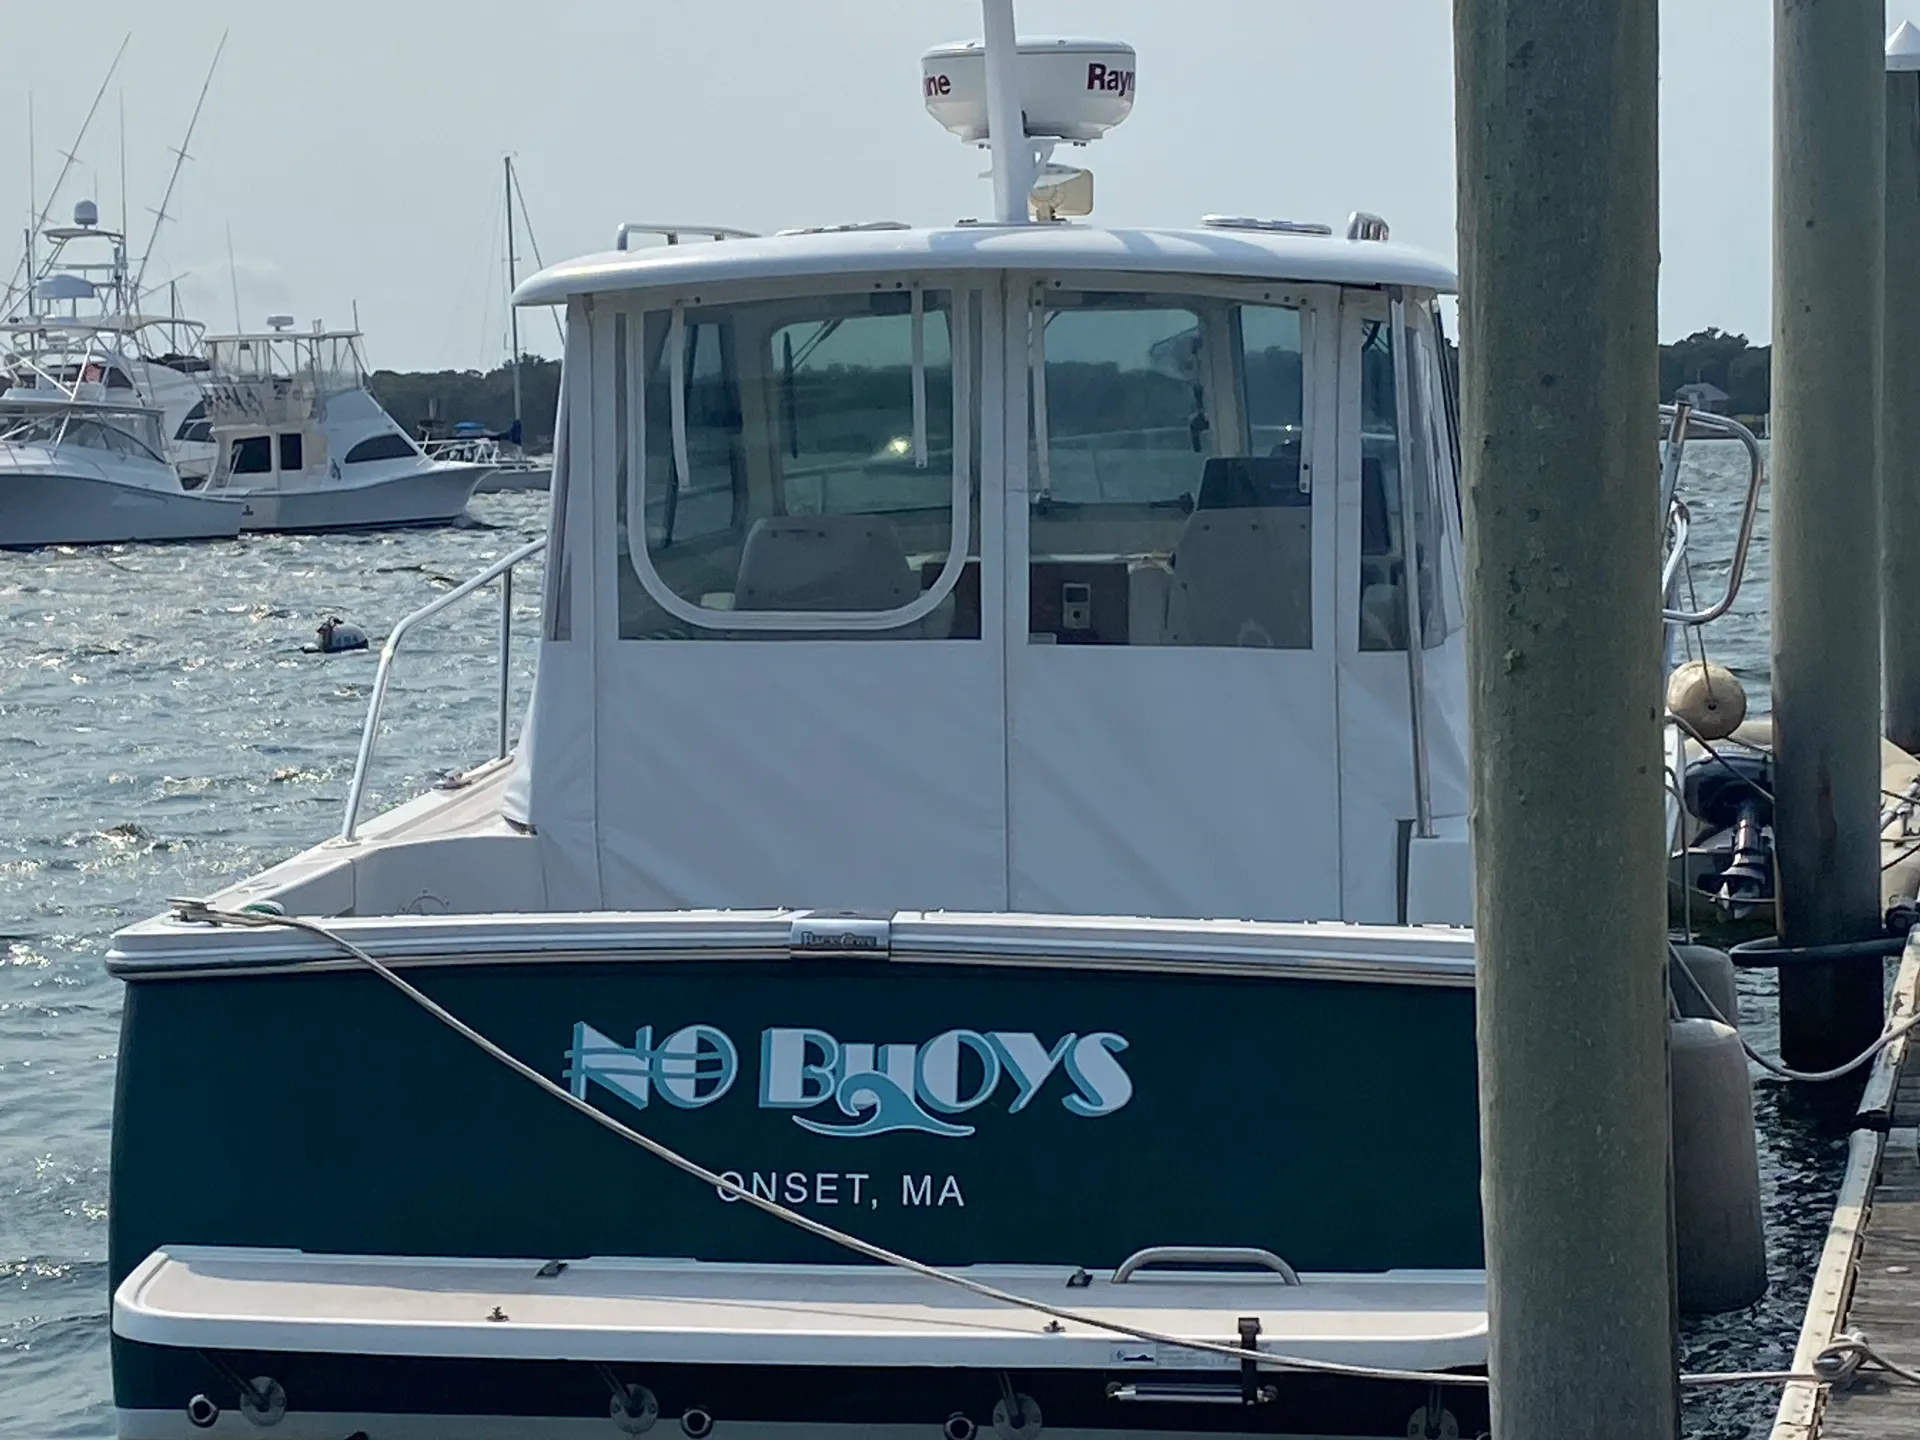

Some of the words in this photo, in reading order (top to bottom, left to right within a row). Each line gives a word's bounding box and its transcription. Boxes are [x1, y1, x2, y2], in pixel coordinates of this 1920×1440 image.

[563, 1021, 738, 1110] NO
[717, 1171, 877, 1210] ONSET,
[902, 1174, 965, 1207] MA
